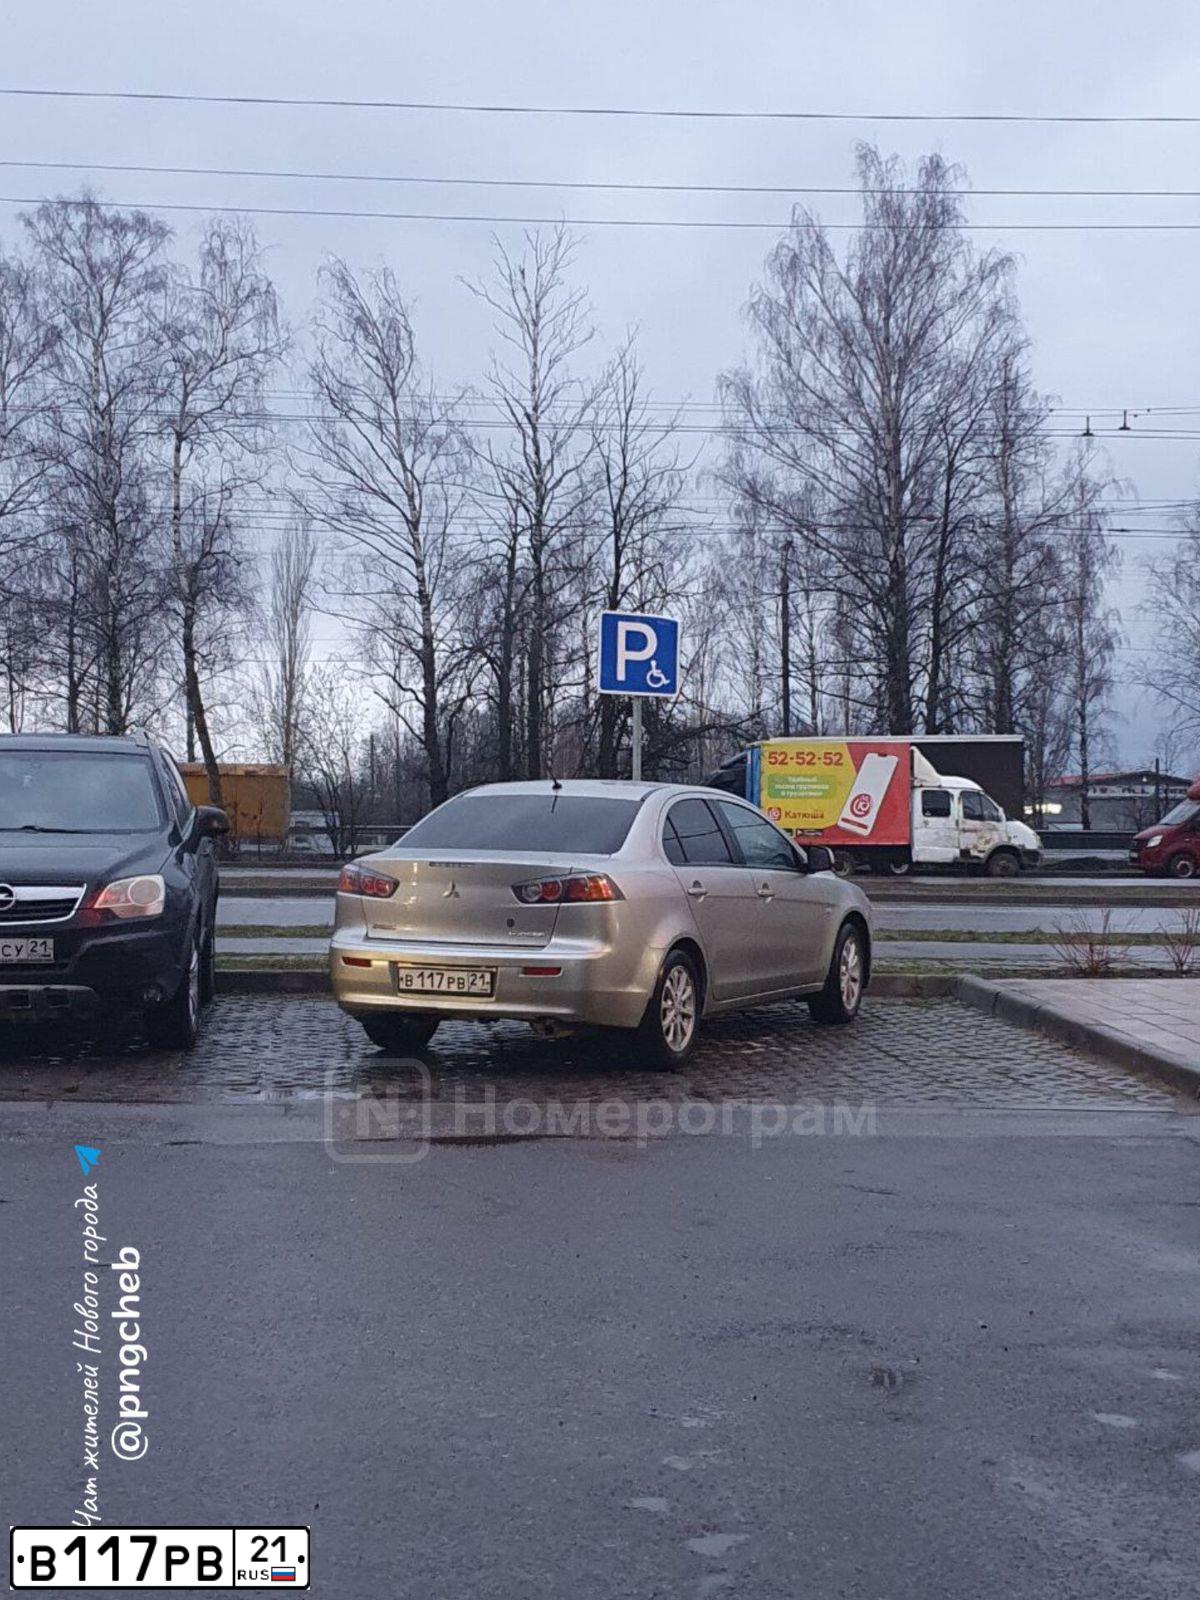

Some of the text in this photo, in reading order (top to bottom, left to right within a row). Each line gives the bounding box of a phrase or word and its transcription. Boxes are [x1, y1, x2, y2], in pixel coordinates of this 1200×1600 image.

[616, 621, 657, 681] P
[784, 810, 824, 819] Катюша
[30, 940, 48, 952] 21
